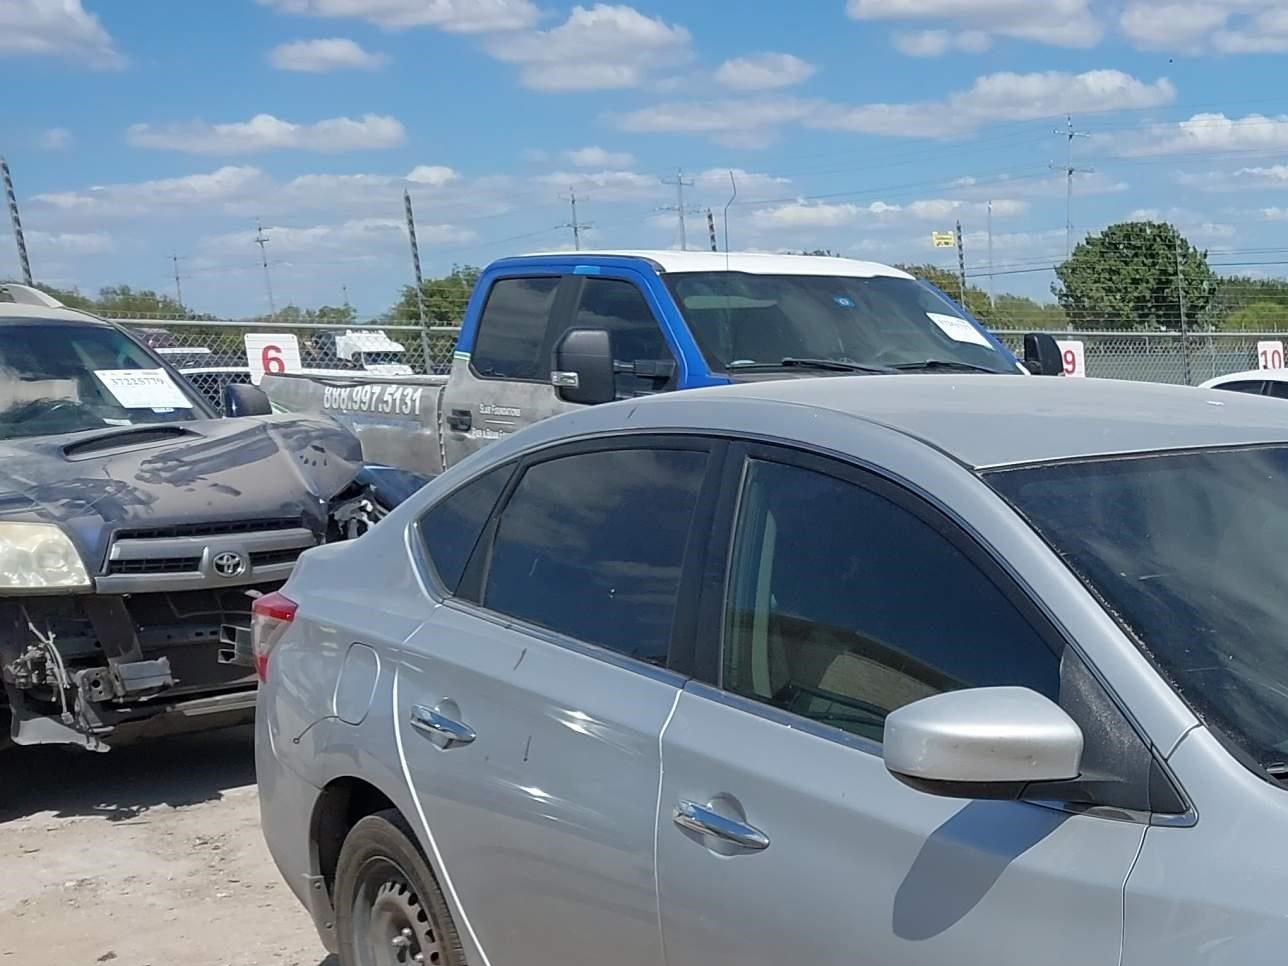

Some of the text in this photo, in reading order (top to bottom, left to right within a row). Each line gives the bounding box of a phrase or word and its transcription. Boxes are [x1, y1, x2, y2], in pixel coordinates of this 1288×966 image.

[261, 345, 285, 374] 6
[1063, 350, 1076, 374] 9
[1260, 350, 1282, 369] 10
[323, 385, 422, 415] 888.997.5131
